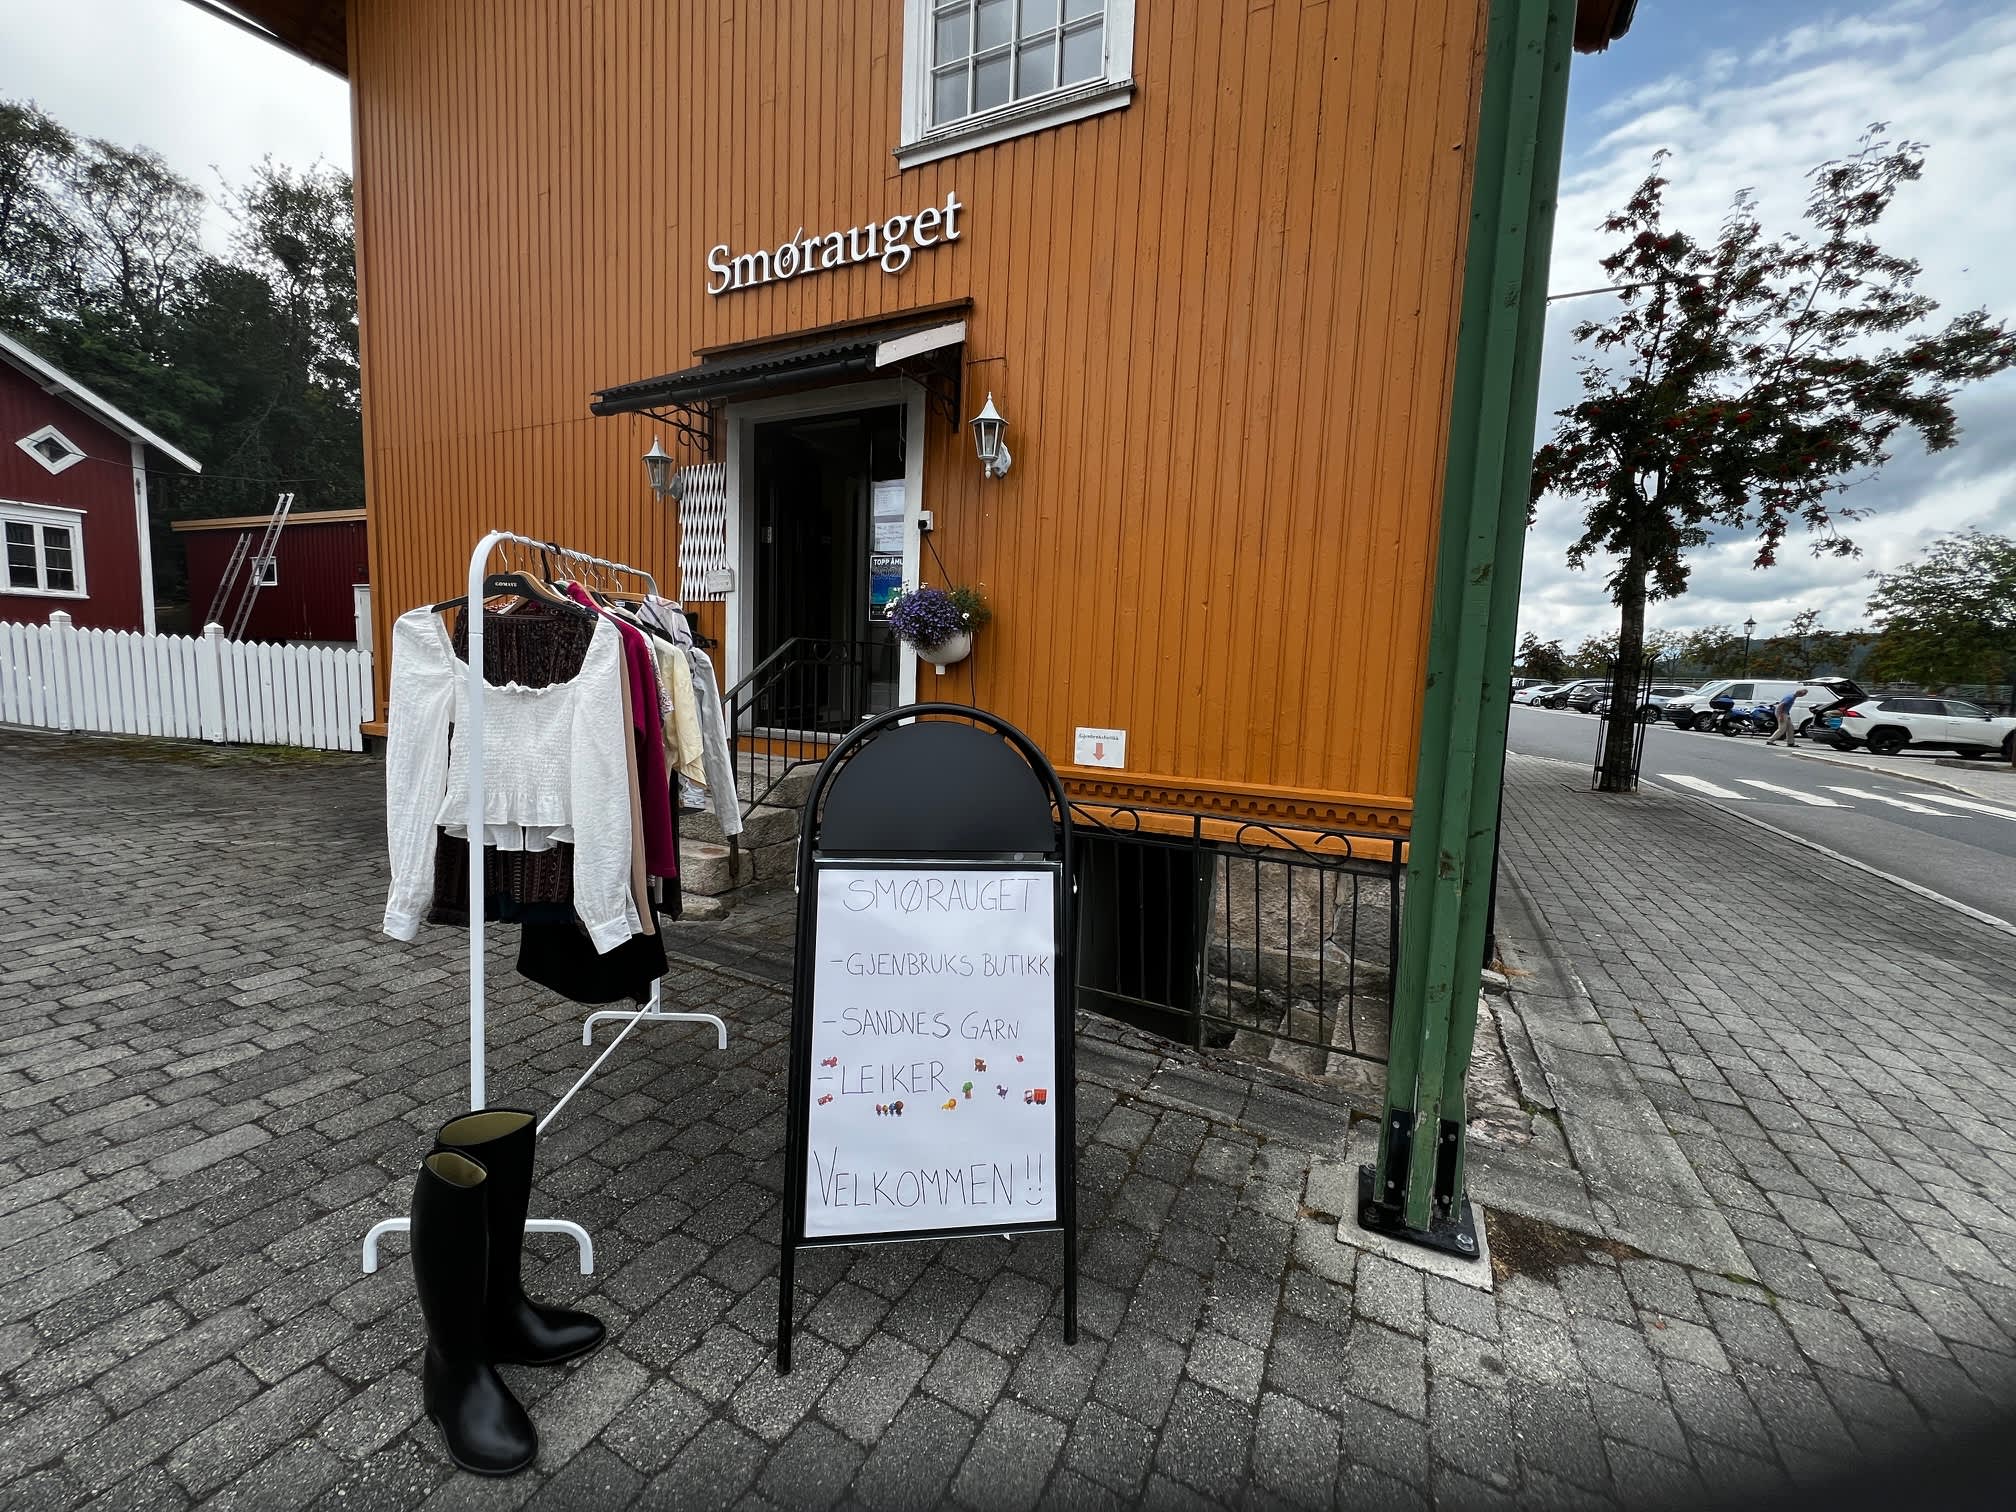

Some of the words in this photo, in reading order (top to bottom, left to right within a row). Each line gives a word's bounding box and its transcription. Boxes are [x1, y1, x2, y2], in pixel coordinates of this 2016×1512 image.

[707, 191, 962, 295] Smørauget
[873, 558, 890, 566] TOPP
[843, 877, 1040, 913] SMØRAUGET
[983, 952, 1051, 977] BUTIKK
[960, 1011, 1019, 1041] GARN
